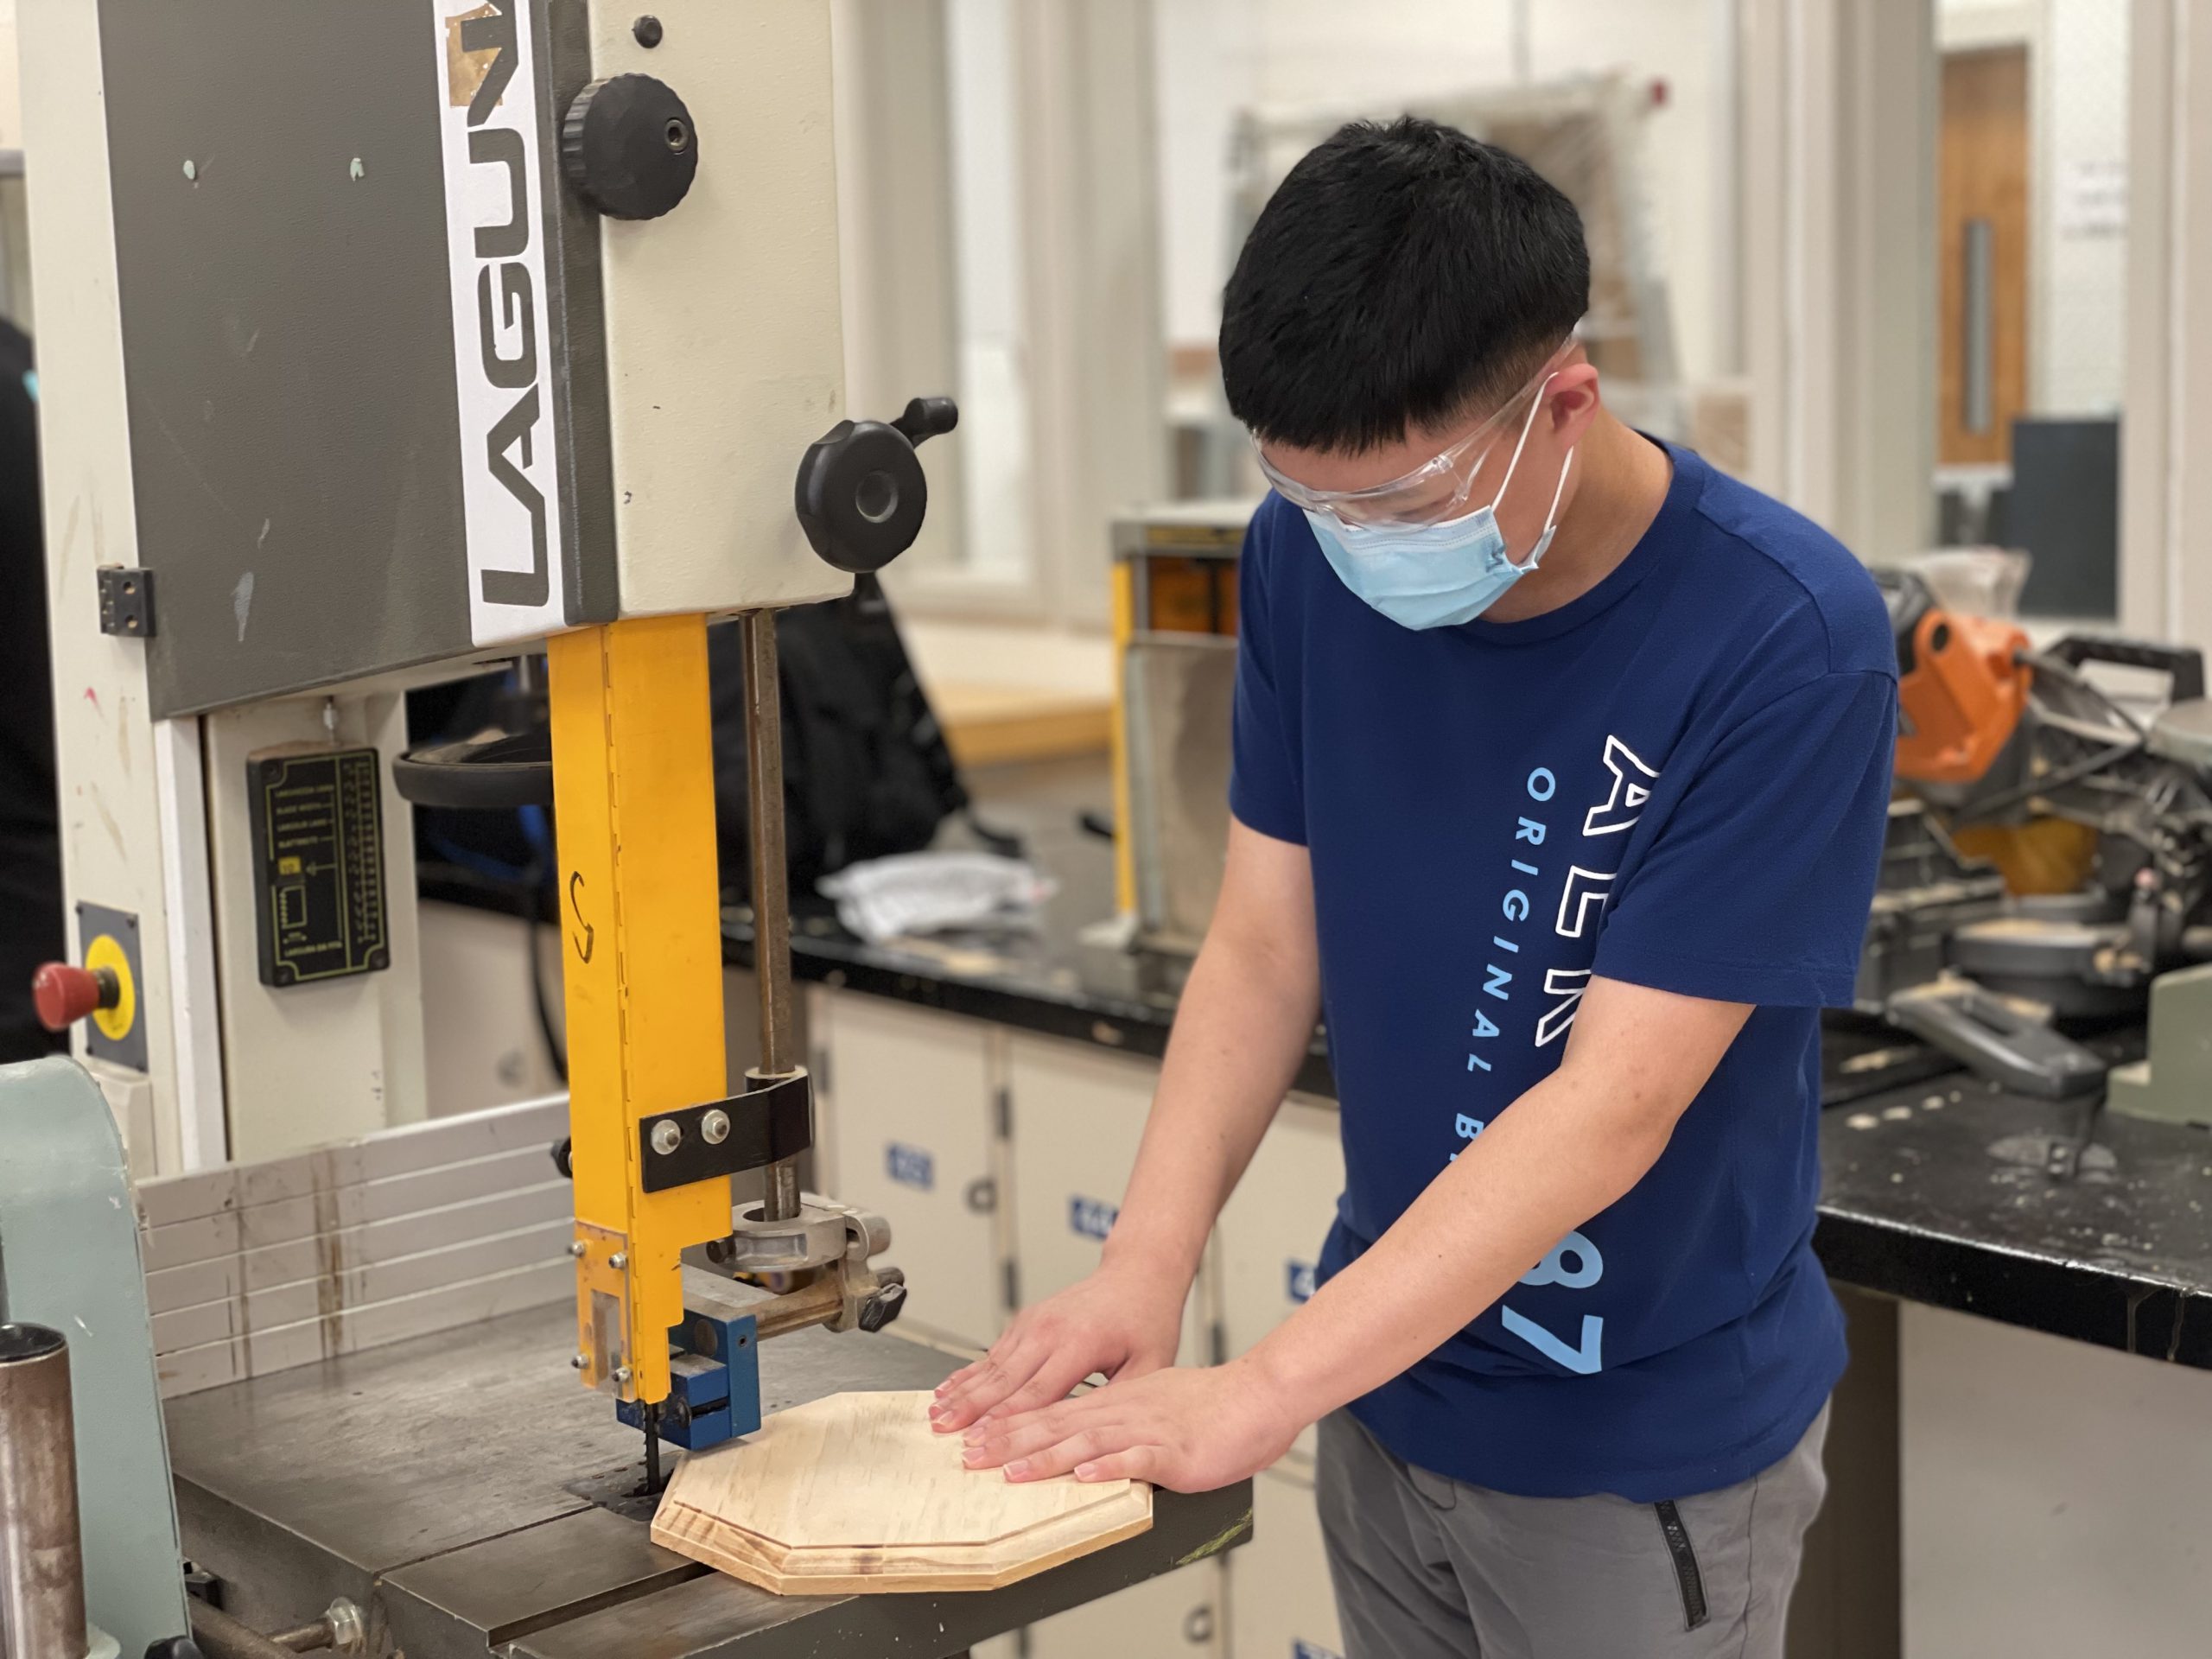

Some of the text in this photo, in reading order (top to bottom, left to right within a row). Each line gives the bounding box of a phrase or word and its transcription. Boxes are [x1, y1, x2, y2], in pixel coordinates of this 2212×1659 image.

[460, 0, 551, 608] LAGUN
[1449, 766, 1556, 1162] ORIGINAL B
[1502, 1230, 1604, 1375] 87
